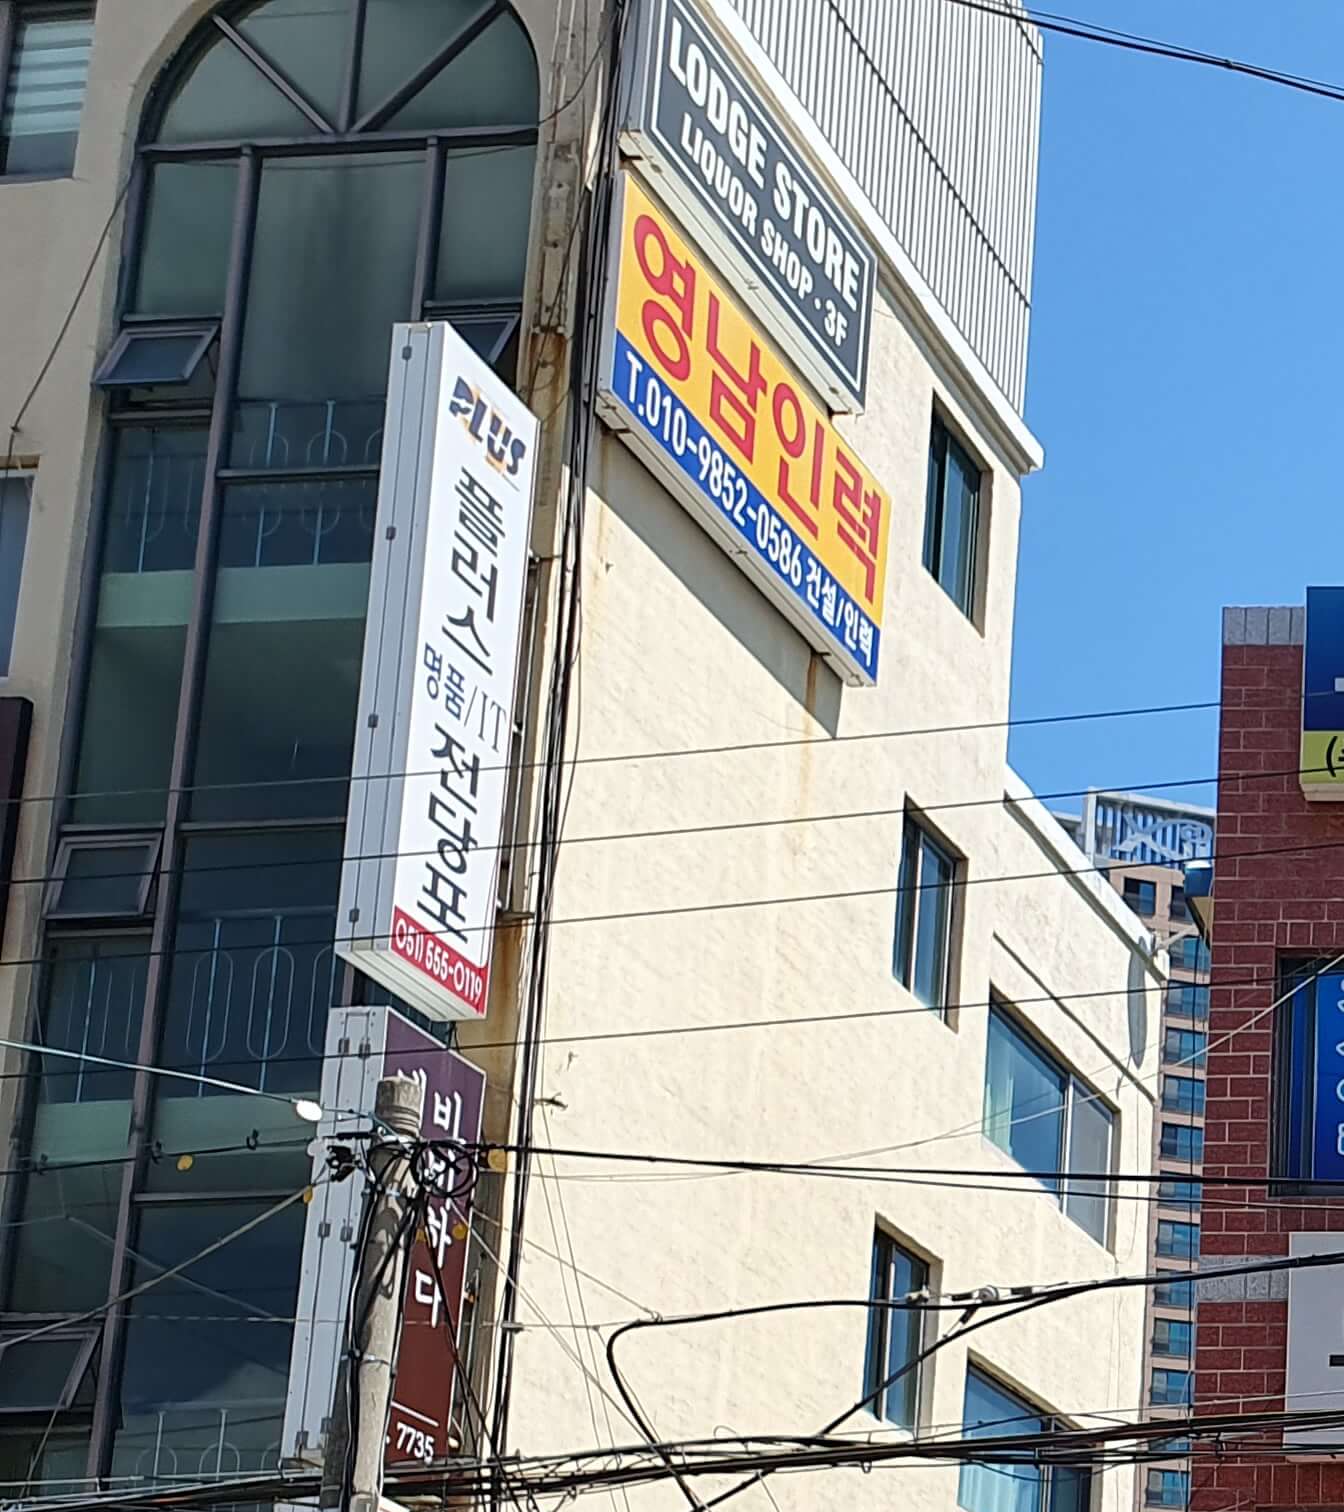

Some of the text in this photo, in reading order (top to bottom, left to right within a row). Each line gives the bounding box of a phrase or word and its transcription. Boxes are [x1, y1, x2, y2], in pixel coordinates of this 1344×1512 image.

[669, 15, 861, 308] LODGE STORE
[680, 111, 849, 347] LIQUOR SHOP 3F
[449, 375, 526, 478] PLUS
[624, 351, 803, 588] T.010-9852-0586
[633, 214, 881, 601] 영남인력
[442, 465, 507, 678] 플러스
[415, 723, 480, 944] 전당포
